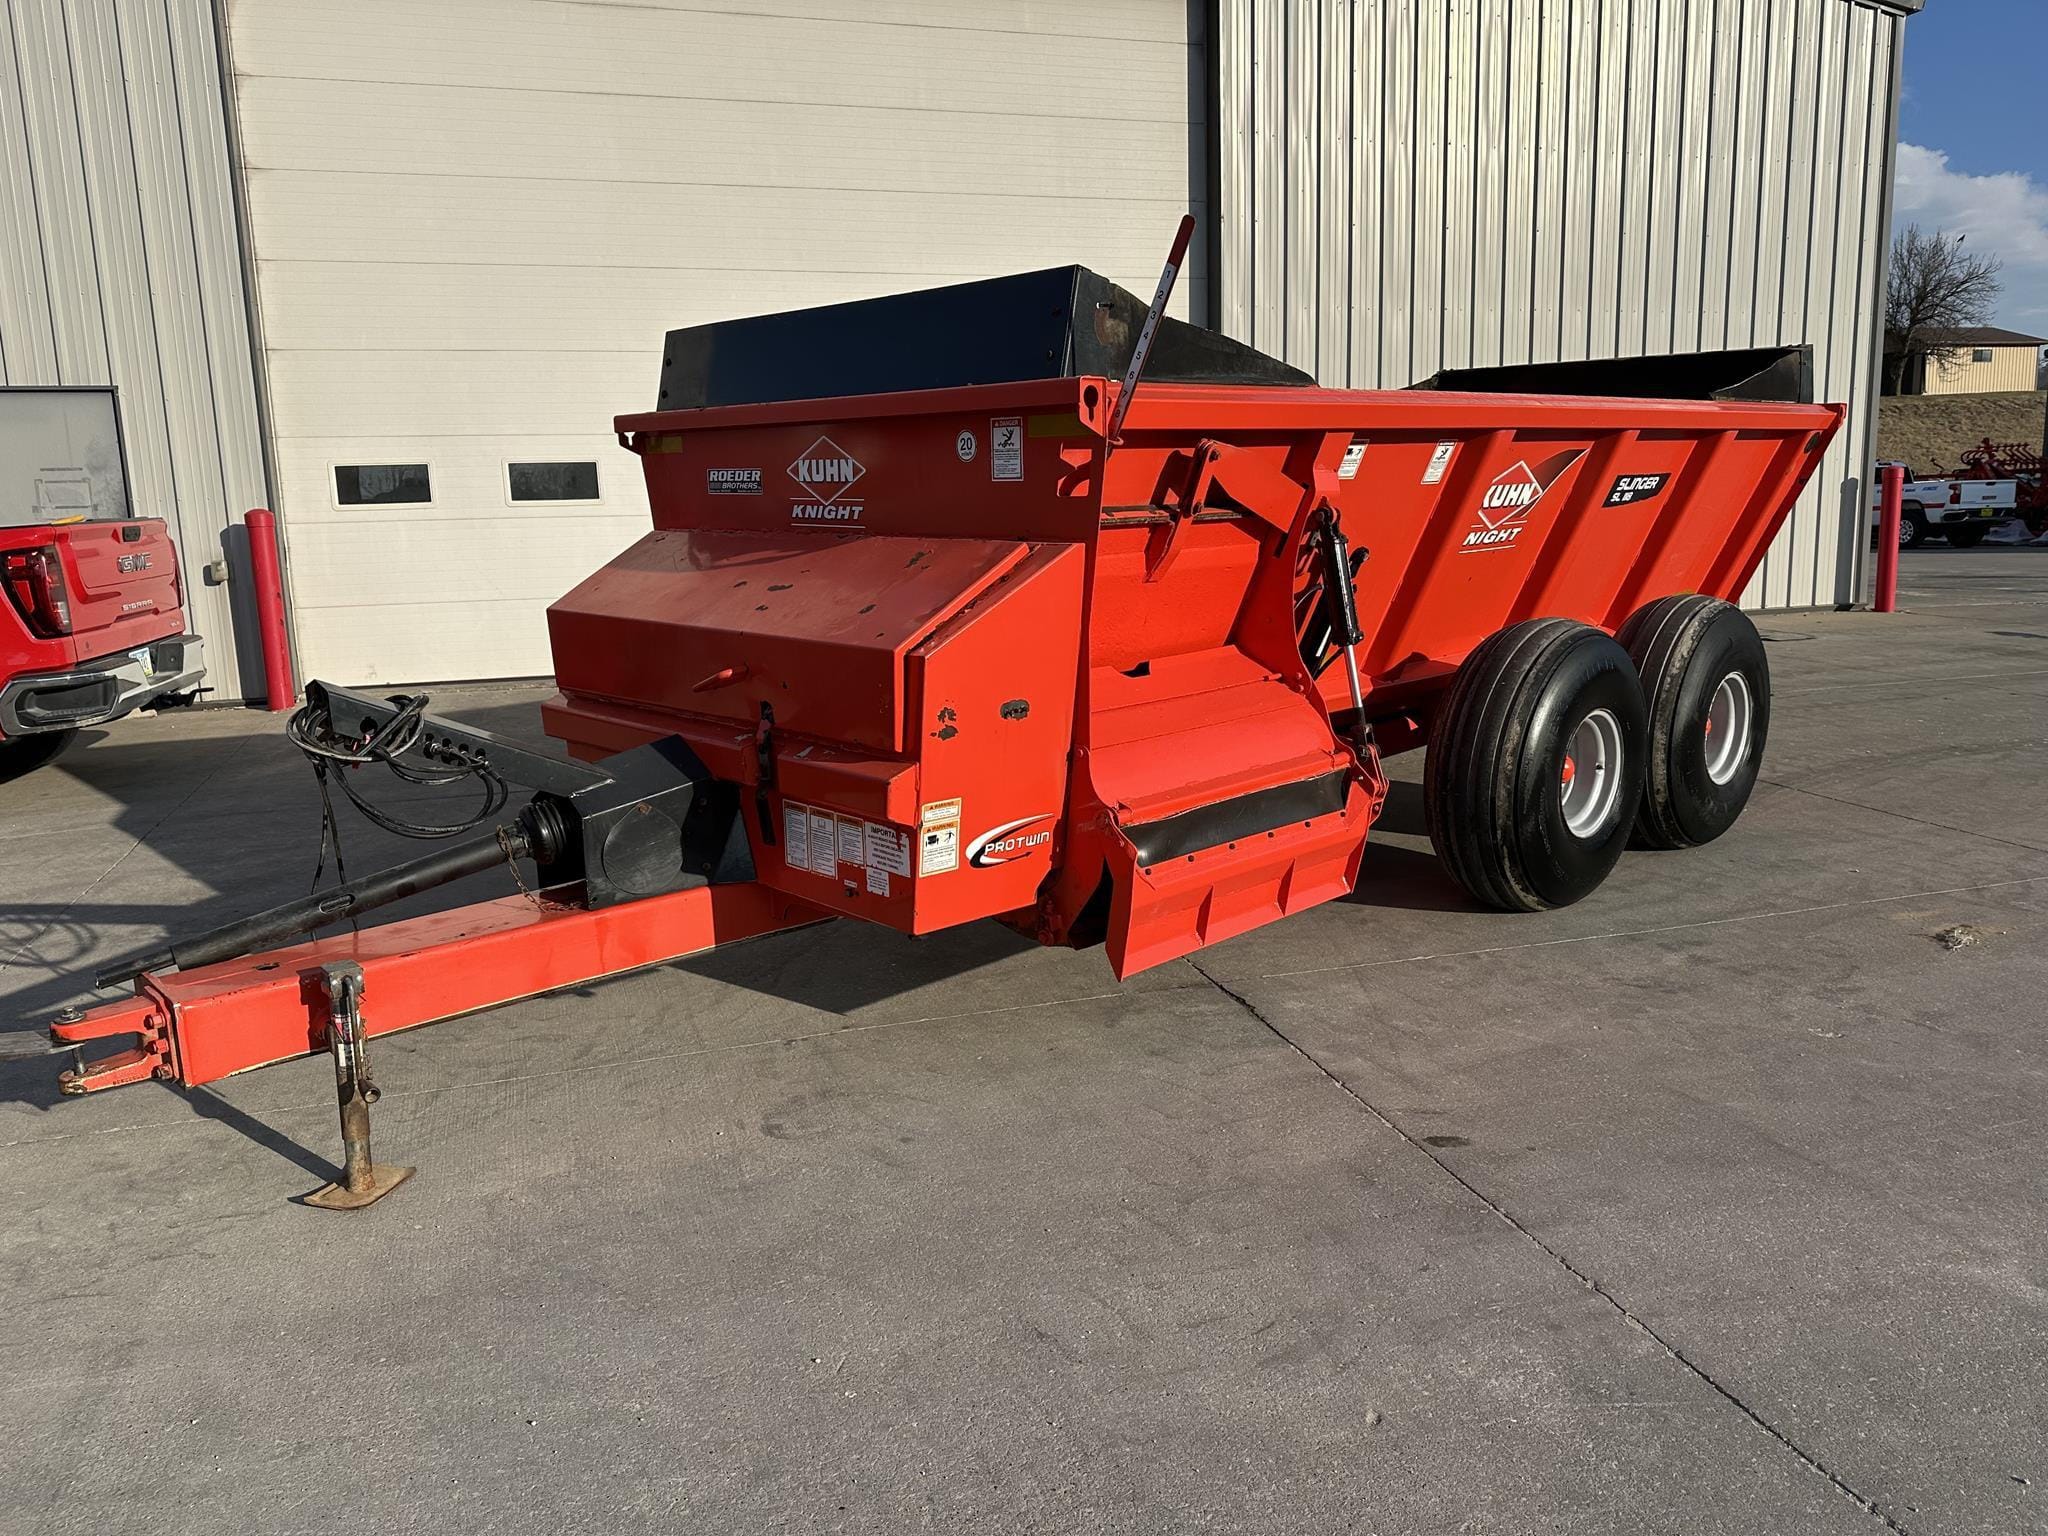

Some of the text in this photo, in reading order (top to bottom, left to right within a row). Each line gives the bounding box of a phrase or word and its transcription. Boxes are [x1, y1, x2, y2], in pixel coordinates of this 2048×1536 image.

[1114, 270, 1171, 418] 1 2 3 4 5 6 7 8
[960, 437, 973, 451] 20
[709, 470, 761, 482] ROEDER
[798, 458, 854, 482] KUHN
[722, 481, 758, 490] BROTHERS
[1616, 476, 1660, 491] SLINGER
[1610, 492, 1621, 502] SL
[791, 504, 864, 520] KNIGHT
[118, 553, 152, 573] GMC
[122, 599, 153, 611] SIERRA
[870, 825, 896, 840] IMPORTA
[984, 831, 1050, 856] PROTWIN
